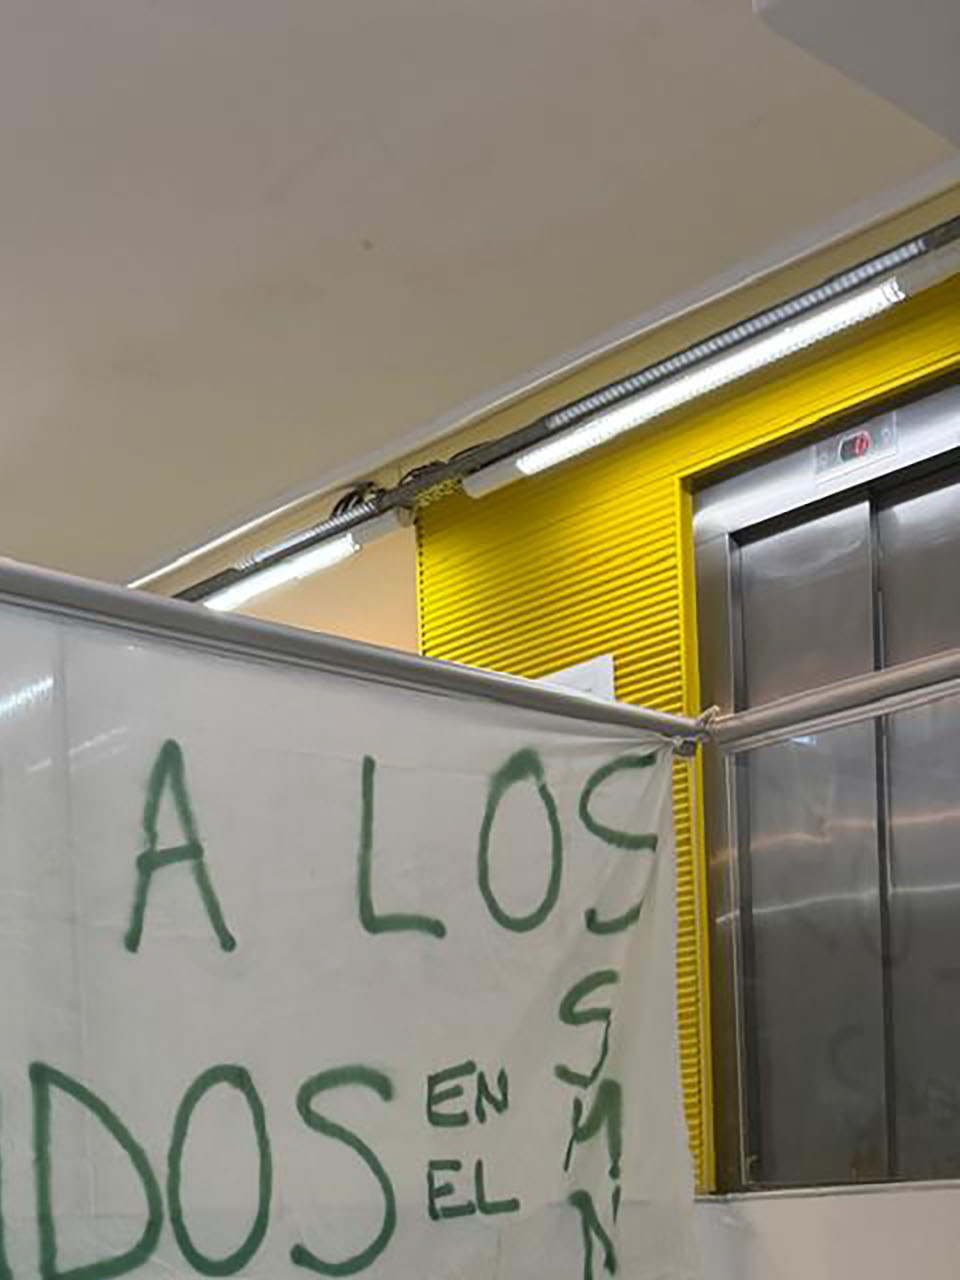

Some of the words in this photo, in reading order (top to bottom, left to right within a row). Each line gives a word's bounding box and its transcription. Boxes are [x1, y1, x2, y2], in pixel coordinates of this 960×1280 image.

[125, 738, 237, 953] A
[358, 747, 657, 940] LOS
[426, 1060, 509, 1128] EN
[426, 1159, 521, 1221] EL
